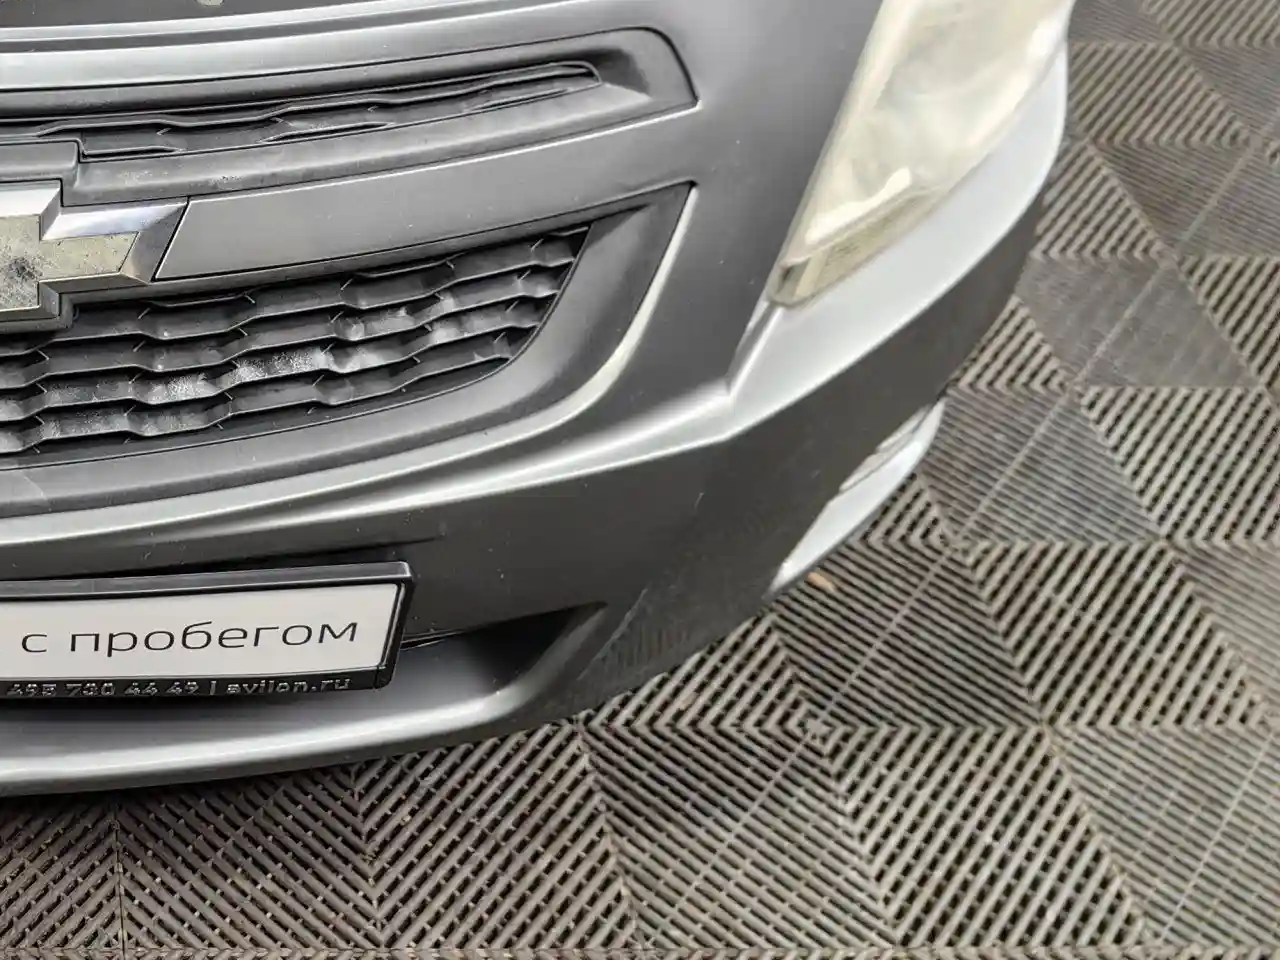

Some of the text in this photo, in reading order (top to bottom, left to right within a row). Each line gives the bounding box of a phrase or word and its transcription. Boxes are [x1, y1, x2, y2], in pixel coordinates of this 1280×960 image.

[21, 633, 49, 653] с
[69, 620, 359, 658] пробегом
[226, 678, 351, 695] avilon.ru
